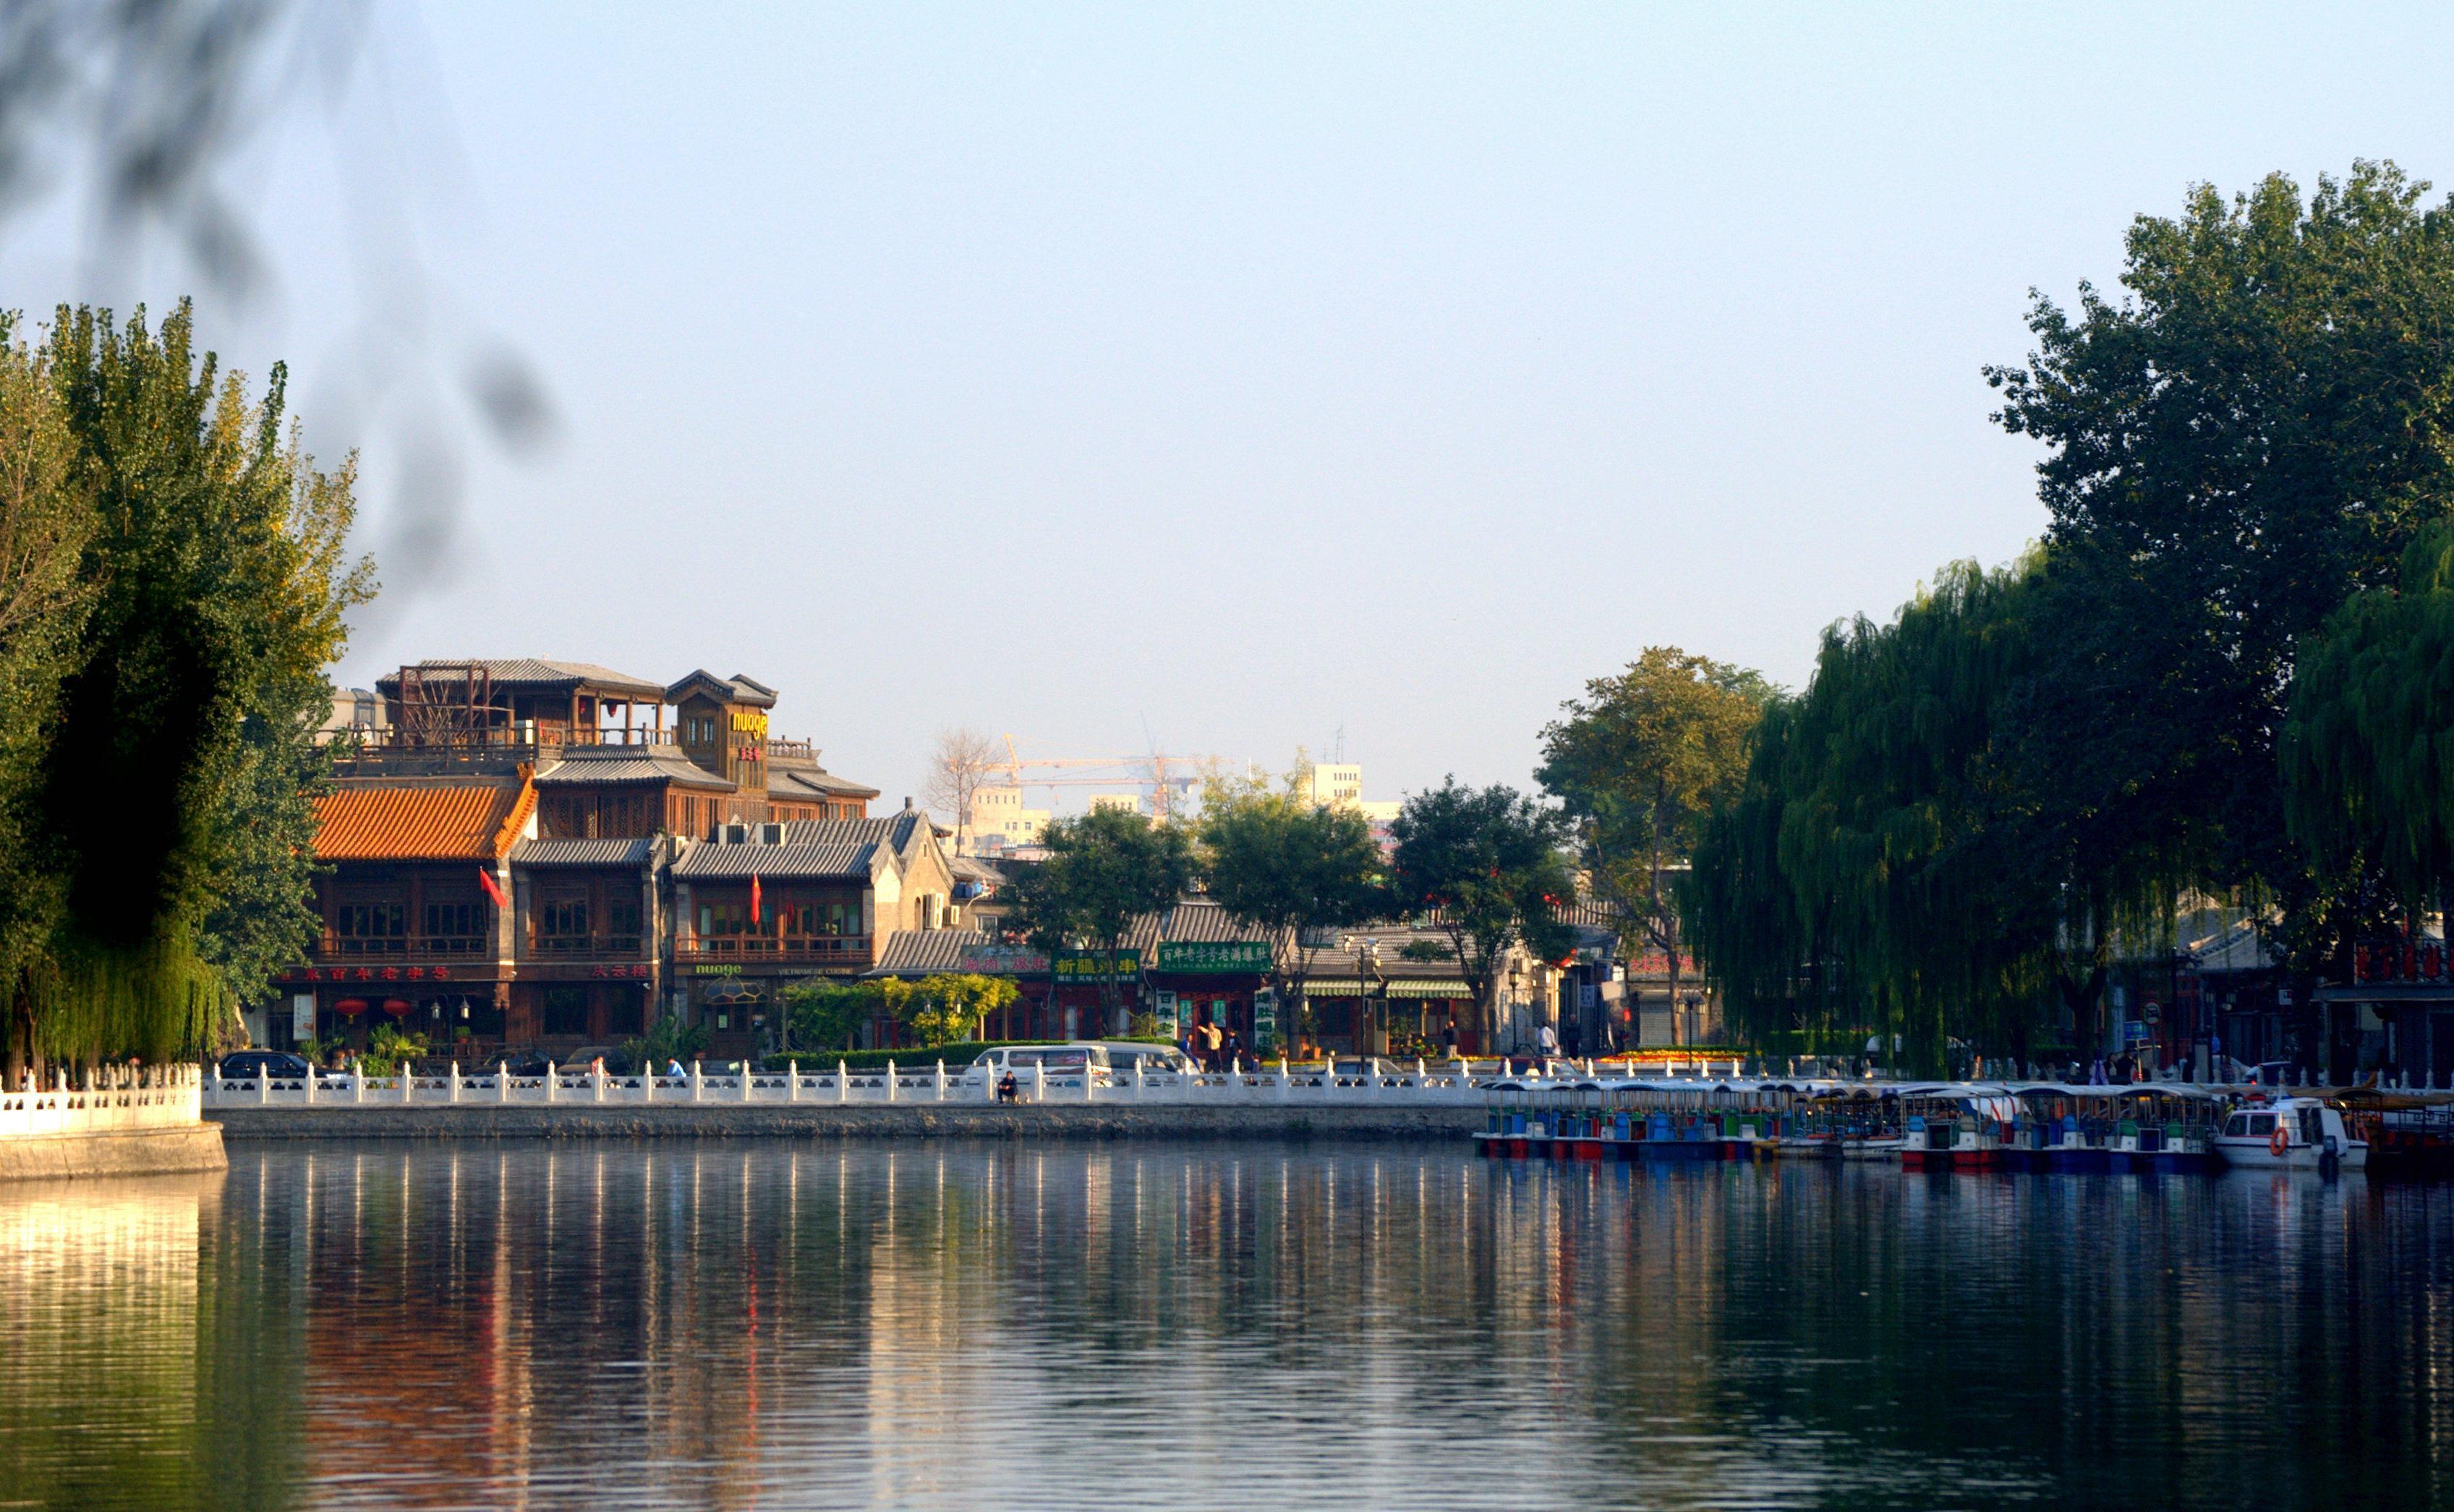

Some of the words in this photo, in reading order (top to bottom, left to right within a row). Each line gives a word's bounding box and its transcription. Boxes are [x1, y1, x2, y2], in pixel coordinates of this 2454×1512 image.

[733, 713, 767, 740] nuage
[696, 965, 741, 976] nuage
[825, 967, 853, 975] CUISINE
